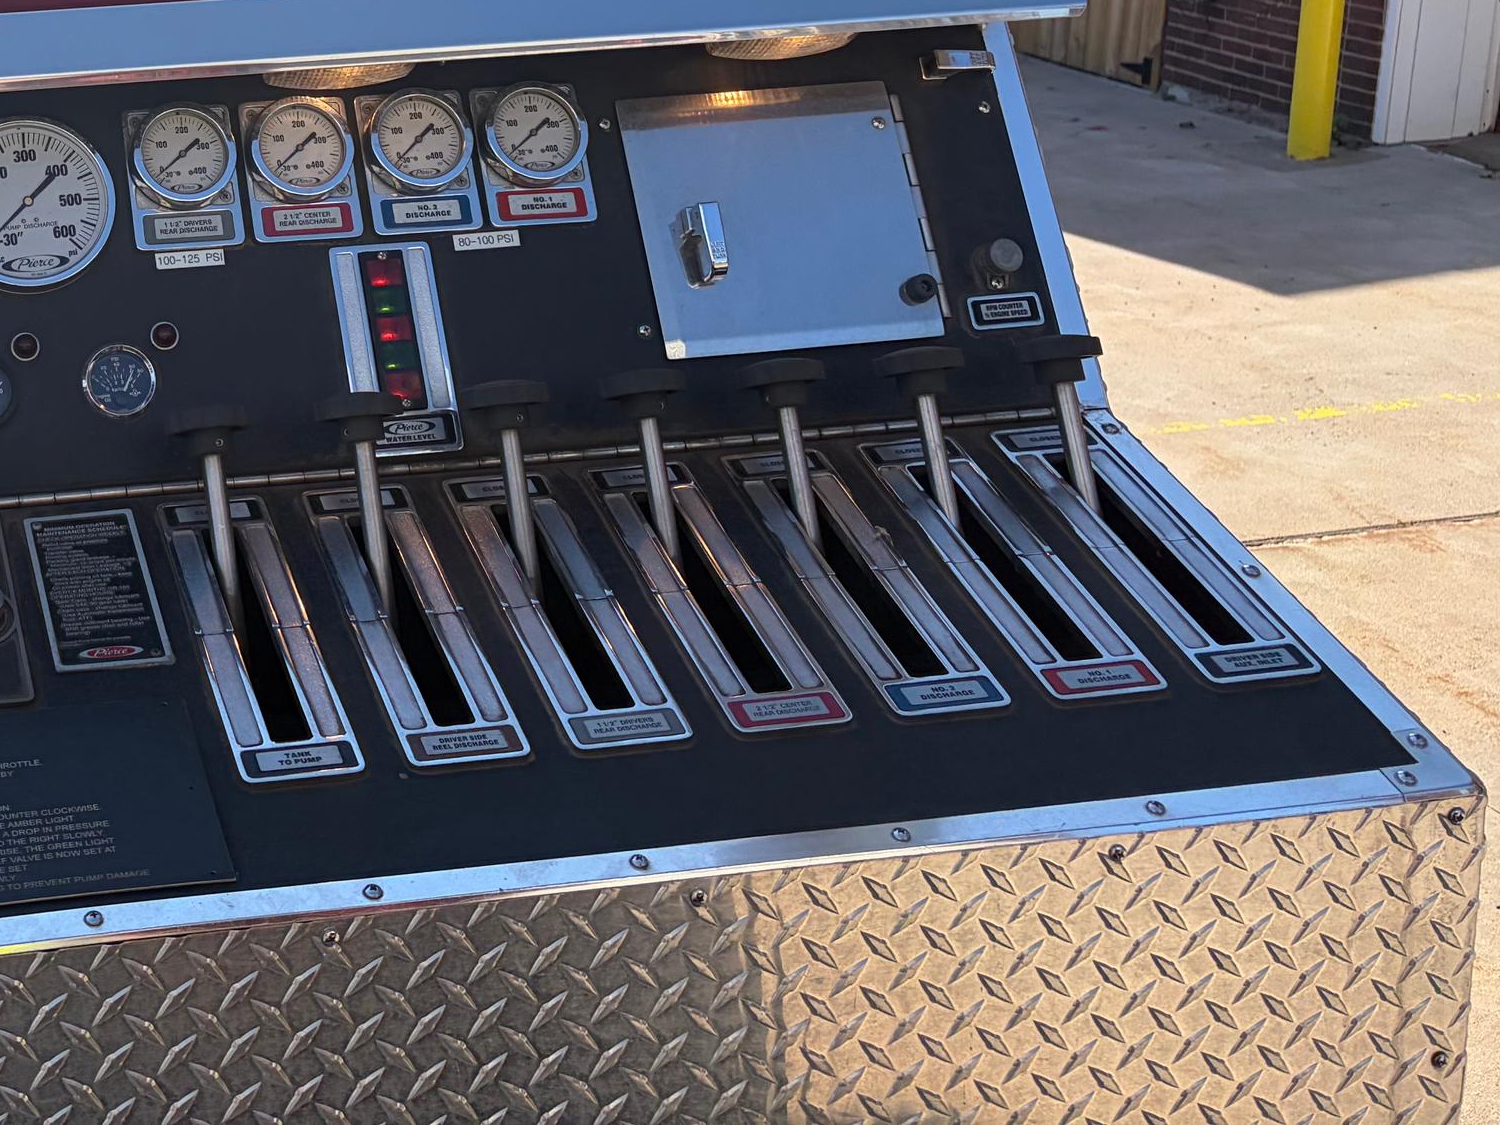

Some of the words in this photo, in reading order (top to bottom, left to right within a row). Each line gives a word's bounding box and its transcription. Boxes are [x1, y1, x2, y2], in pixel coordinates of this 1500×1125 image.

[13, 149, 36, 163] 300
[45, 163, 68, 177] 400
[59, 193, 82, 207] 500
[521, 202, 568, 211] DISCHARGE
[406, 210, 452, 219] DISCHARGE
[299, 218, 337, 226] DISCHARGE
[52, 224, 76, 239] 600
[179, 226, 218, 234] DISCHARGE
[458, 236, 494, 247] 80-100
[497, 234, 514, 244] PSI
[18, 256, 55, 270] Pierce
[158, 254, 200, 265] 100-125
[206, 252, 224, 262] PSI
[93, 647, 128, 659] Pierce
[1224, 654, 1256, 663] DRIVER
[1259, 652, 1280, 660] SIDE
[1233, 661, 1255, 669] AUX.
[1257, 657, 1284, 666] INLET
[1077, 673, 1132, 684] DISCHARGE
[920, 689, 976, 701] DISCHARGE
[432, 743, 453, 751] REEL
[455, 739, 499, 749] DISCHARGE
[438, 736, 468, 744] DRIVER
[284, 751, 312, 759] TANK
[293, 756, 322, 765] PUMP
